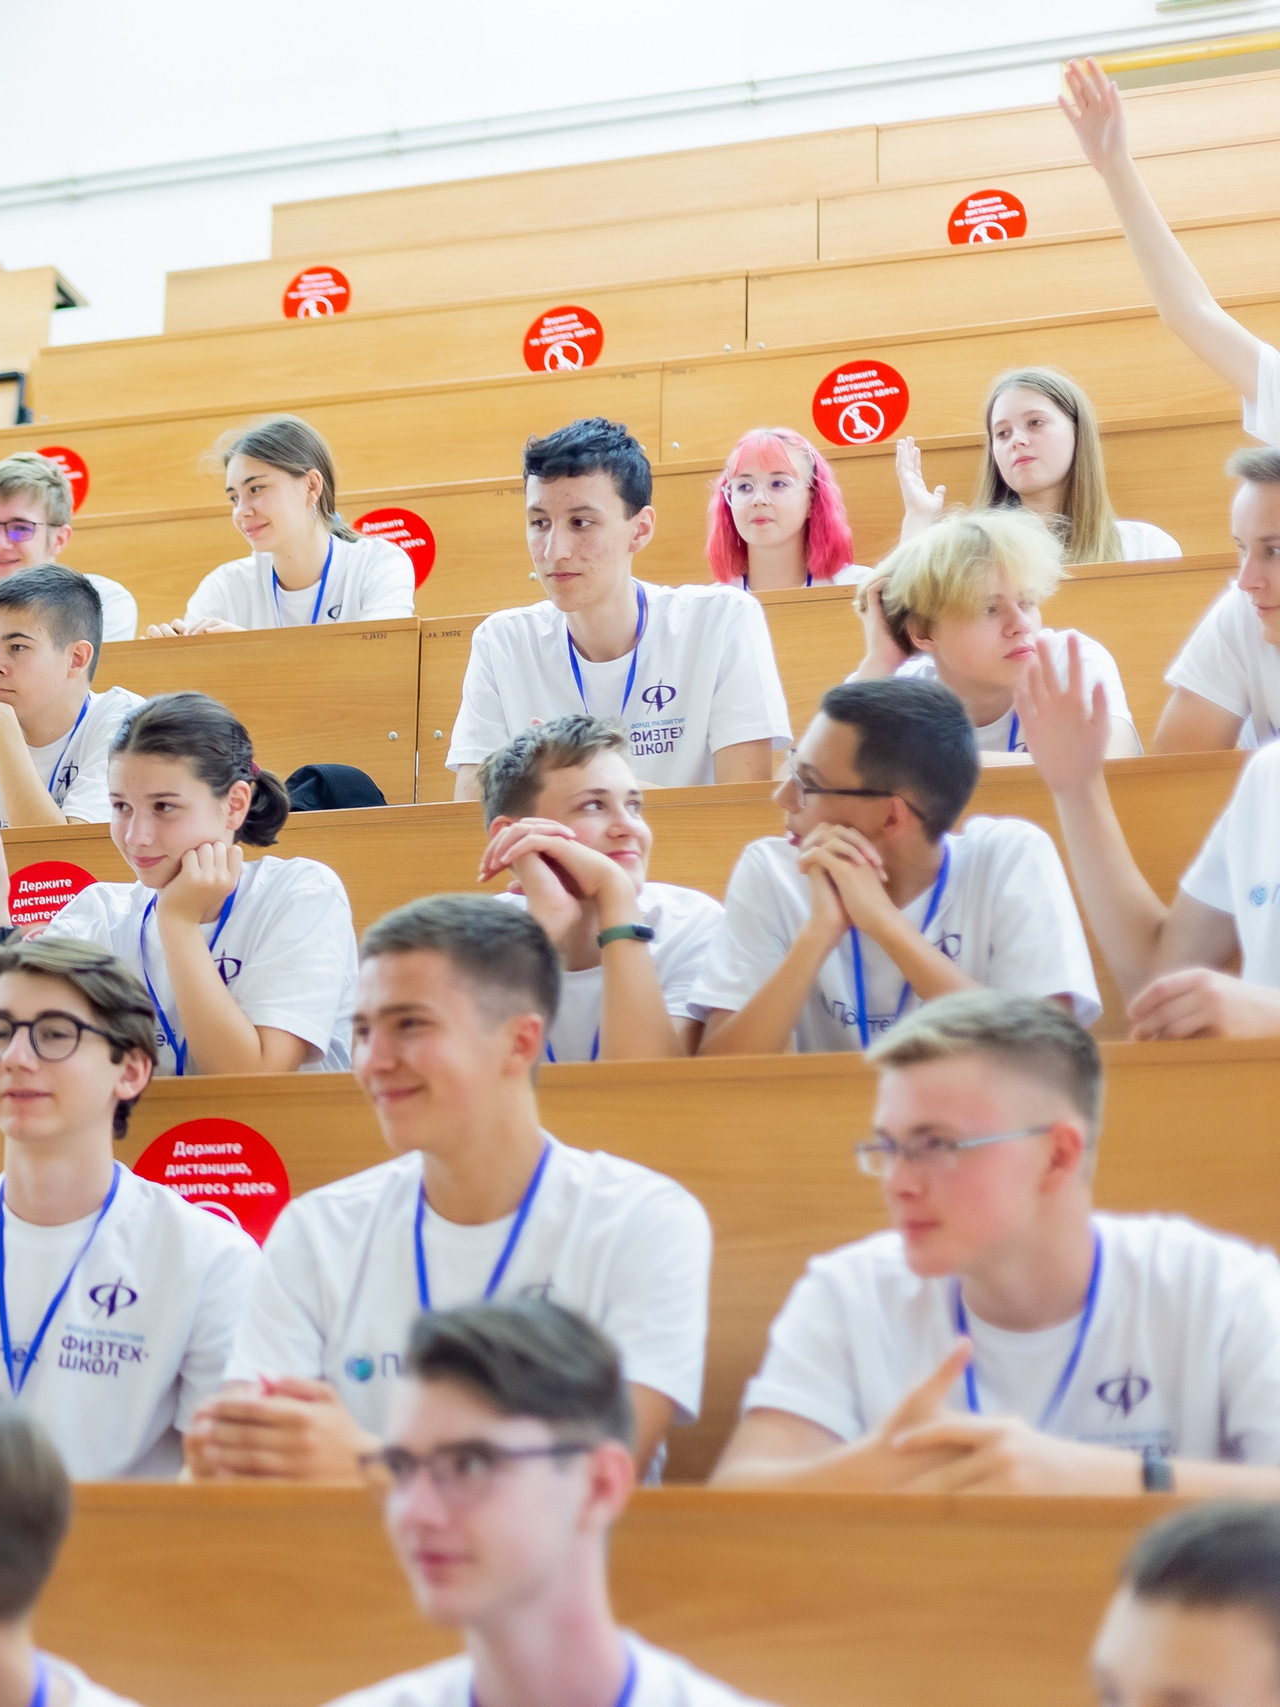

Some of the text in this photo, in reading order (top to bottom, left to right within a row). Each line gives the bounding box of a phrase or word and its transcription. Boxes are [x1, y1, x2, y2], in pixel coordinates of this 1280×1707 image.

[632, 741, 674, 756] ШКОЛ
[19, 879, 72, 893] Держите
[173, 1141, 243, 1157] Держите
[165, 1163, 252, 1177] дистанцию,
[232, 1182, 276, 1196] здесь
[58, 1353, 119, 1377] ШКОЛ
